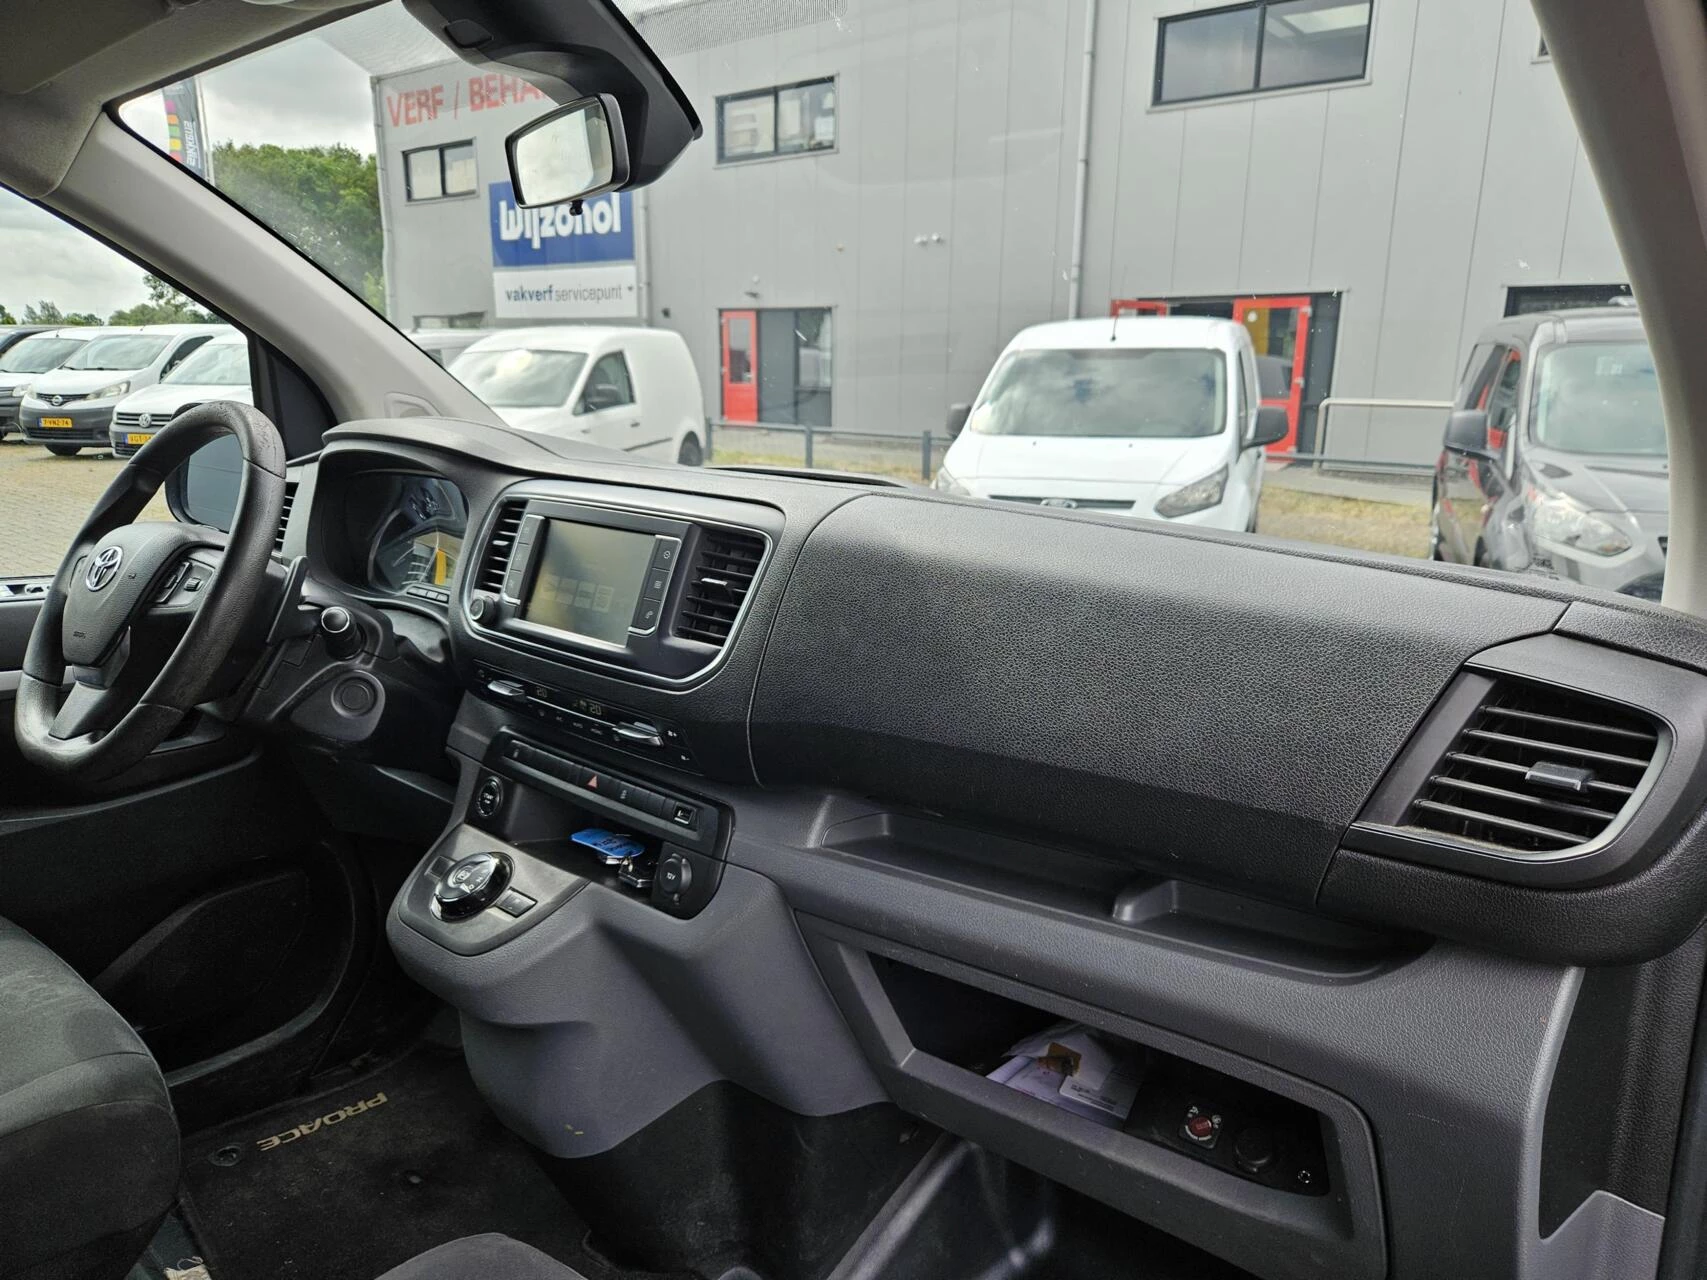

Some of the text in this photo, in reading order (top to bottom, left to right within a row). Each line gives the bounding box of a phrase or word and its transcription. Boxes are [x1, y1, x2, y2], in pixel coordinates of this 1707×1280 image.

[387, 84, 444, 128] VERF
[468, 73, 549, 112] BEHA
[505, 284, 553, 302] vakverf
[256, 1092, 388, 1151] PROACE
